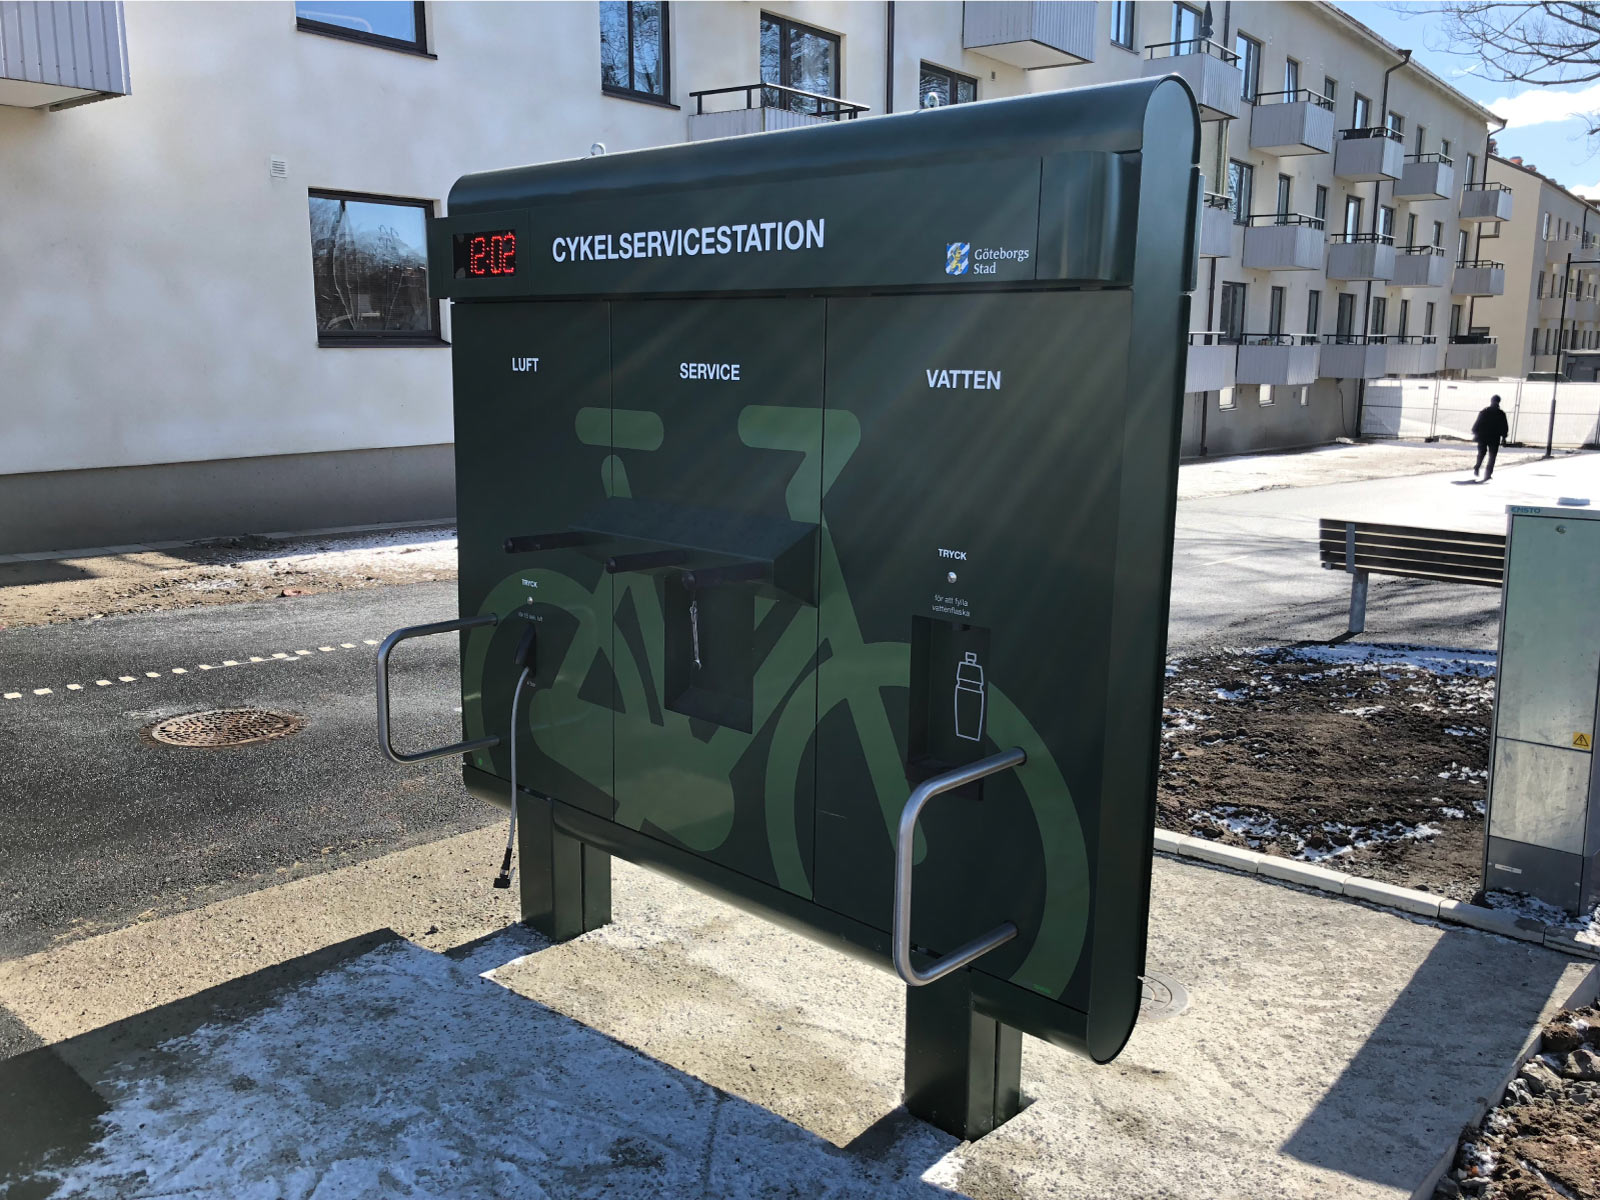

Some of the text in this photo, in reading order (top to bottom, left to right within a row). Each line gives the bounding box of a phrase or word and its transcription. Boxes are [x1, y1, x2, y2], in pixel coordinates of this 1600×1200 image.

[551, 218, 825, 263] CYKELSERVICESTATION
[974, 247, 1029, 262] Göteborgs
[973, 262, 997, 275] Stad
[511, 357, 539, 373] LUFT
[679, 362, 741, 382] SERVICE
[926, 369, 1002, 390] VATTEN
[1511, 506, 1541, 514] ENSTO
[938, 548, 967, 561] TRYCK
